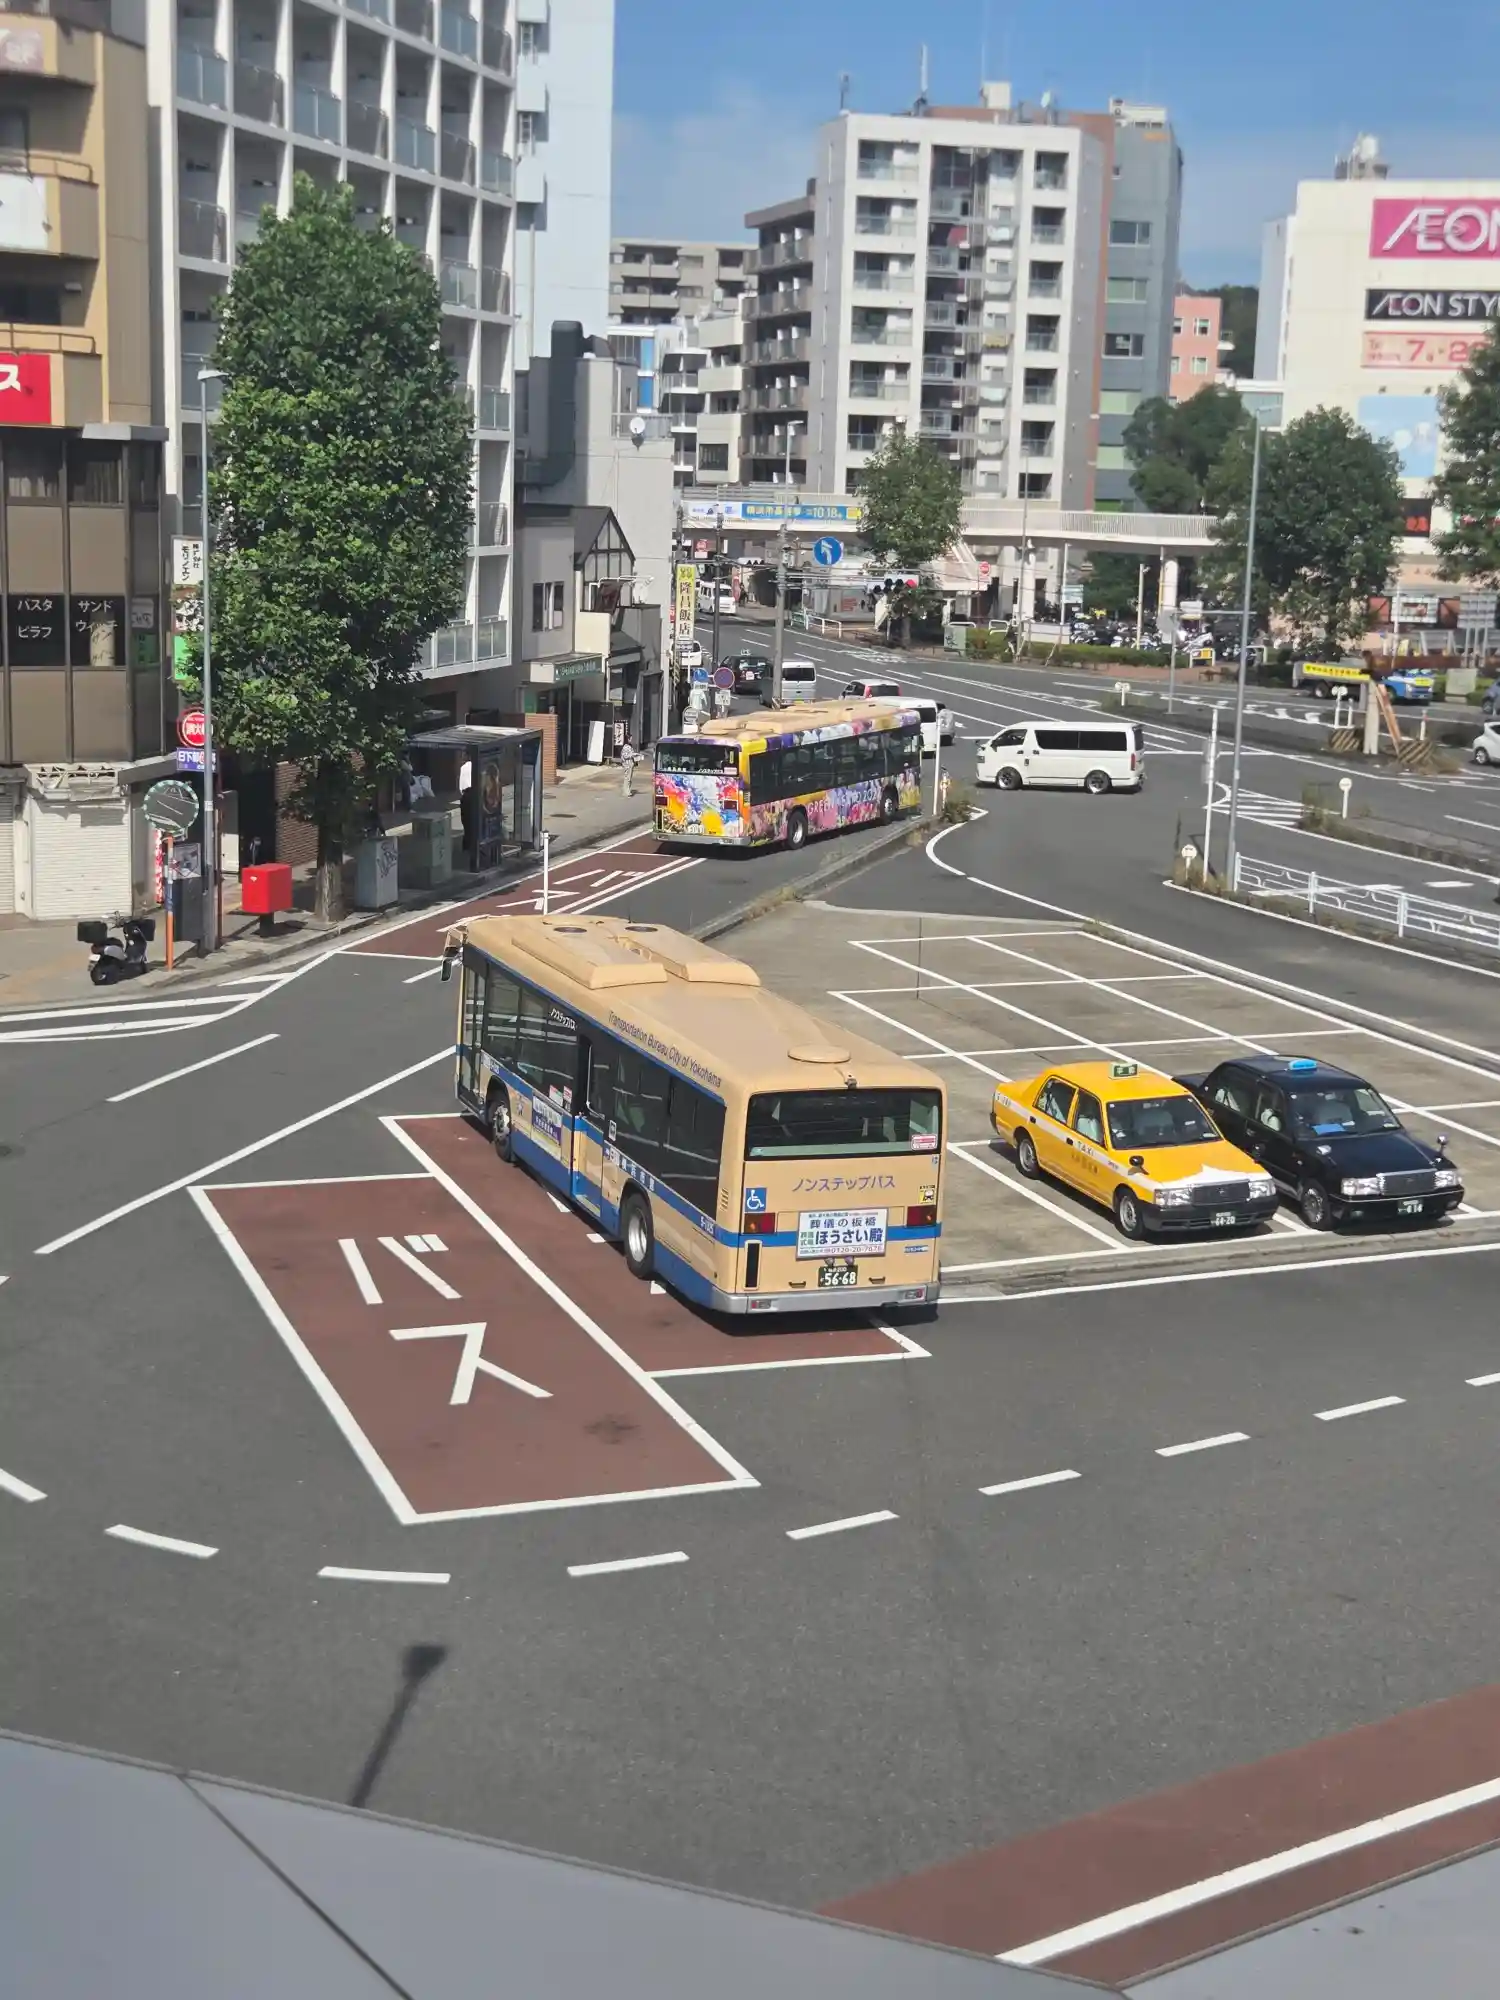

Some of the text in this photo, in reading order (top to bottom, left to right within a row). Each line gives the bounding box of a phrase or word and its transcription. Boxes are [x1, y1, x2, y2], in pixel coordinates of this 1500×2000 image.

[1372, 293, 1441, 316] AEON
[18, 599, 52, 611] パスタ
[78, 600, 112, 612] サンド
[18, 625, 52, 638] ピラフ
[608, 1010, 648, 1043] Transportation
[668, 1046, 681, 1065] City
[681, 1055, 690, 1066] of
[690, 1059, 721, 1088] Yokohama
[792, 1174, 896, 1192] ノンステップバス
[815, 1228, 883, 1245] ほうさい殿
[337, 1233, 553, 1405] バス
